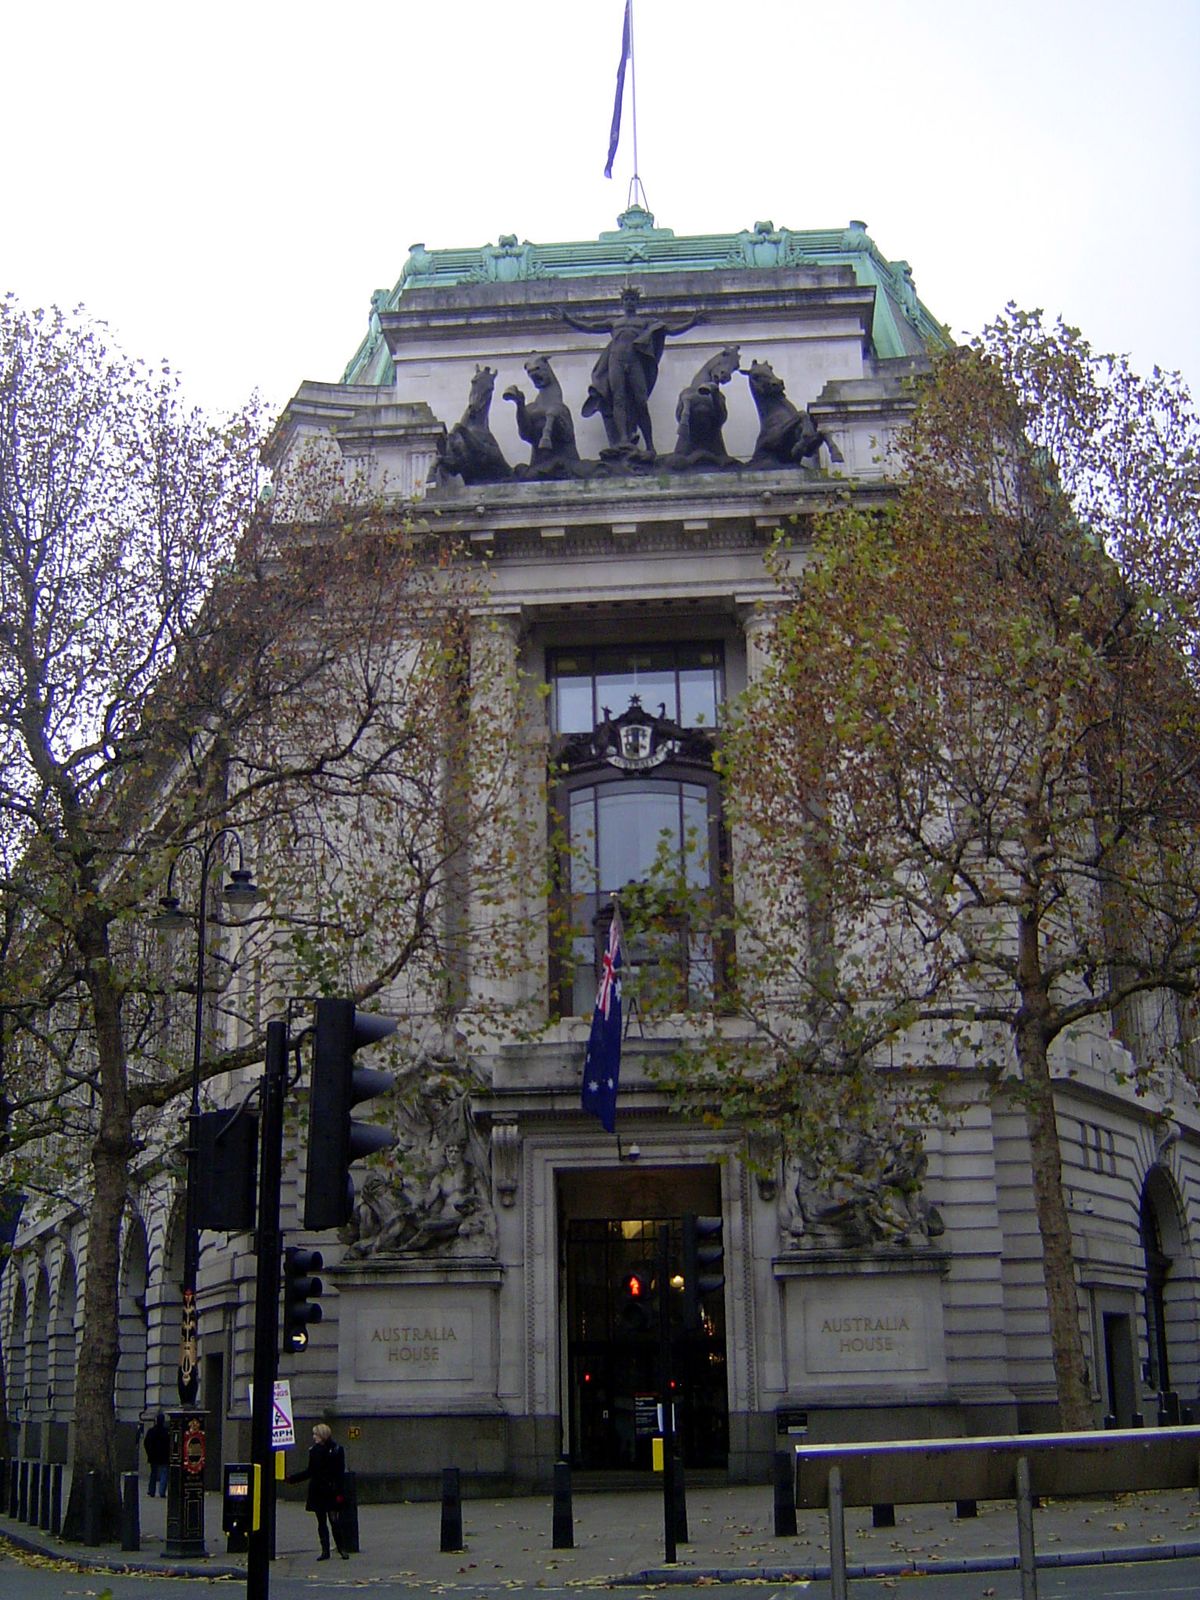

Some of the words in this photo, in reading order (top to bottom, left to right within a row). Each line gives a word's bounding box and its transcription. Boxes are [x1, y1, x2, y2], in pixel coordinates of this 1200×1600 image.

[821, 1316, 909, 1333] AUSTRALIA
[371, 1327, 457, 1342] AUSTRALIA
[840, 1337, 894, 1352] HOUSE
[388, 1347, 440, 1362] HOUSE
[229, 1485, 248, 1496] WAIT
